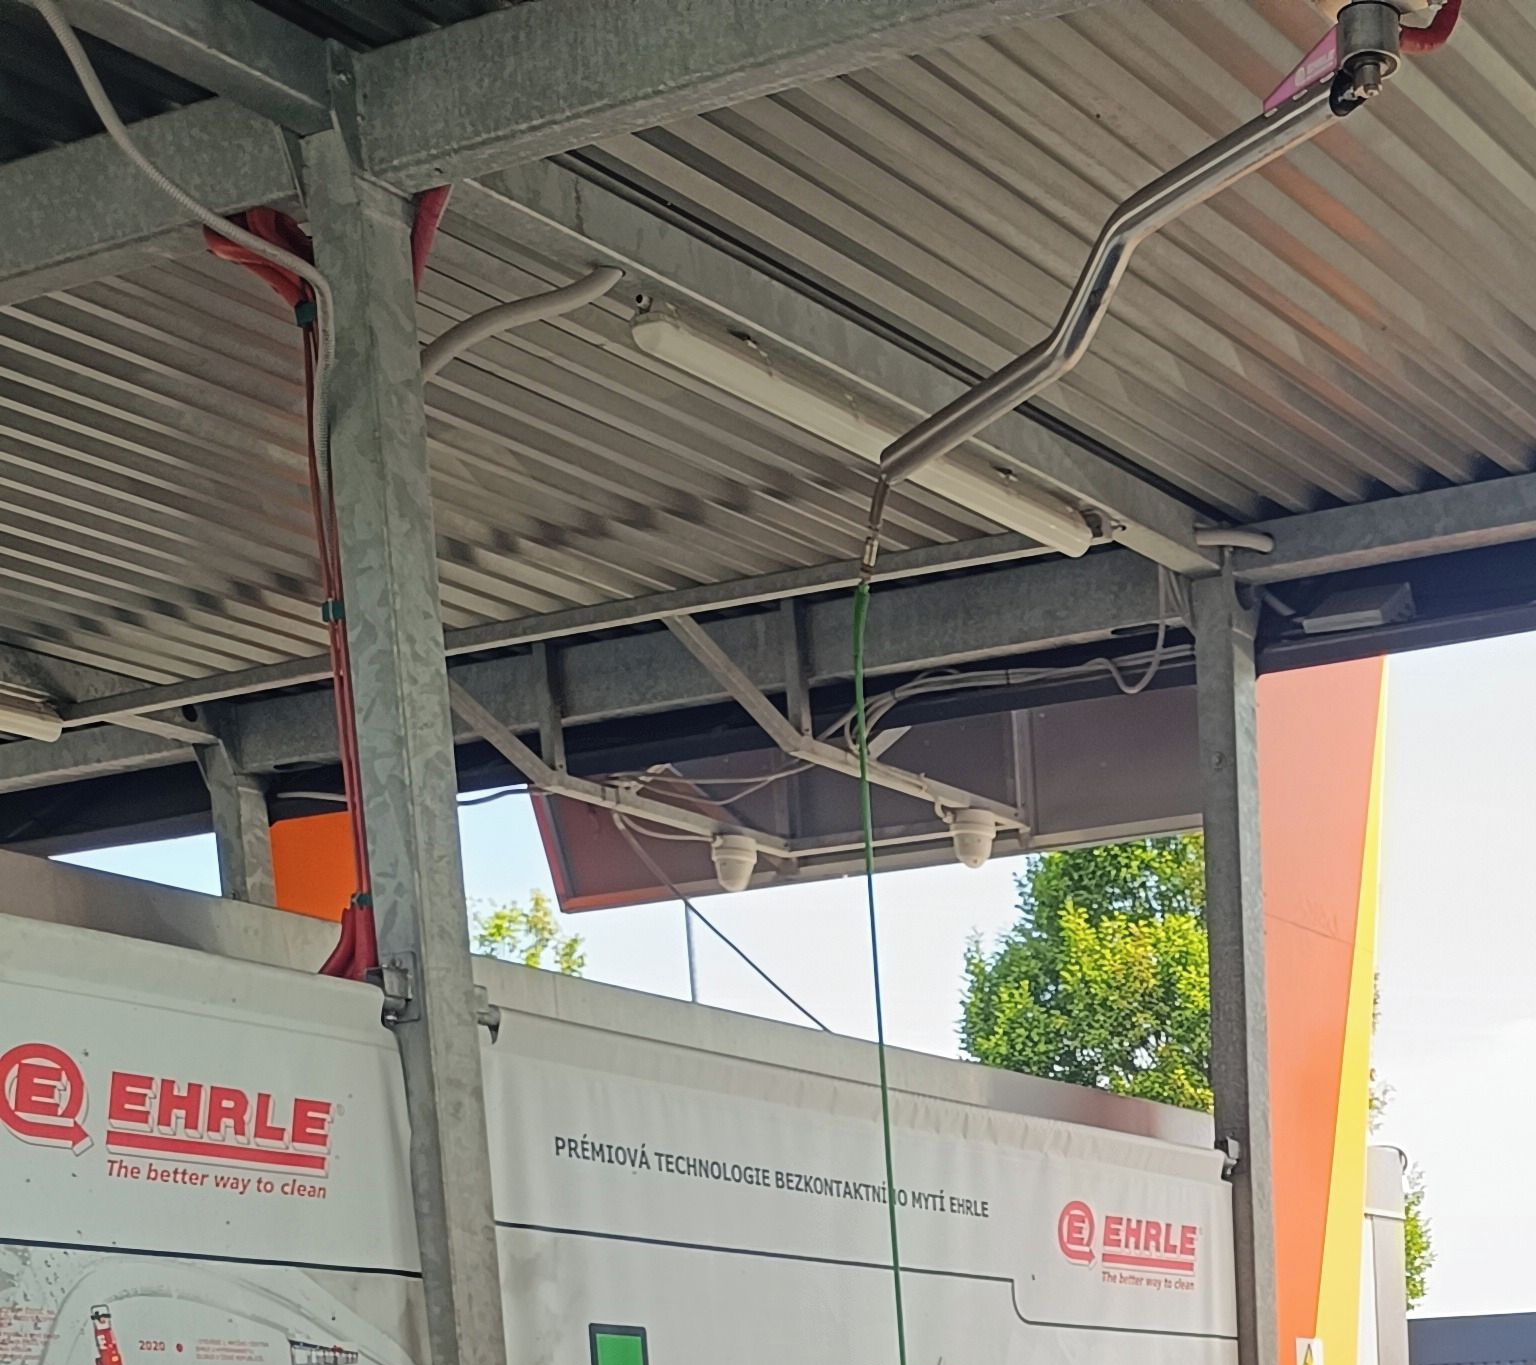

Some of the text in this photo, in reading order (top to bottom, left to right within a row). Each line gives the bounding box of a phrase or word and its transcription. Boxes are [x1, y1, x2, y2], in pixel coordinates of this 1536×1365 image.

[108, 1071, 333, 1150] EHRLE
[107, 1159, 327, 1200] The better way to clean
[554, 1133, 652, 1170] PRÉMIOVÁ
[654, 1151, 771, 1187] TECHNOLOGIE
[911, 1189, 946, 1212] MYTÍ
[949, 1196, 989, 1218] EHRLE
[1103, 1215, 1197, 1257] EHRLE
[1102, 1271, 1195, 1291] The better way to clean
[138, 1340, 166, 1352] 2020
